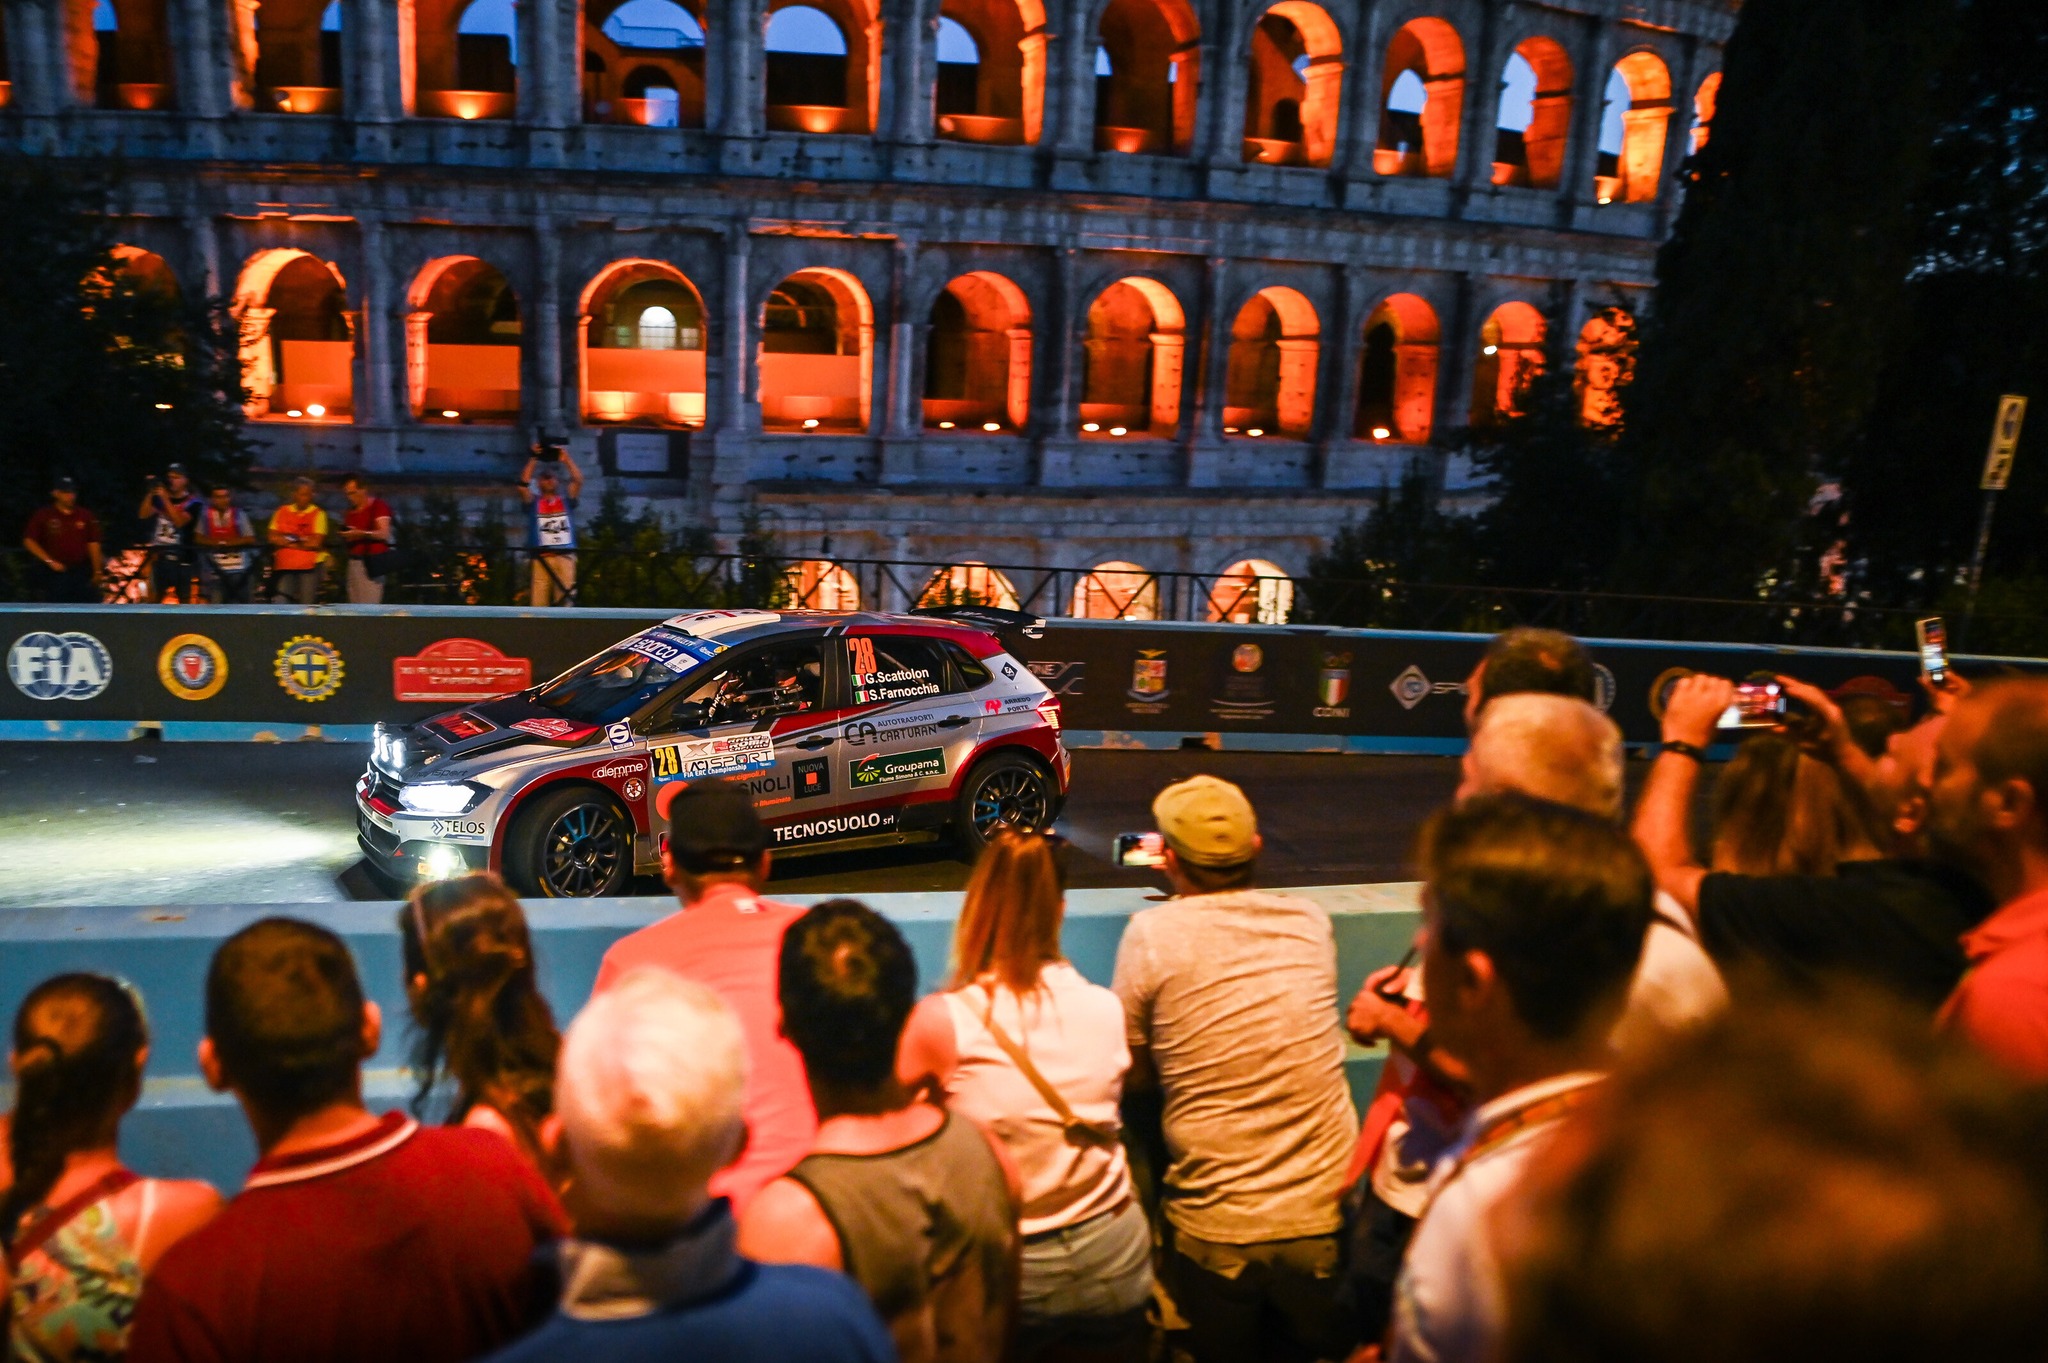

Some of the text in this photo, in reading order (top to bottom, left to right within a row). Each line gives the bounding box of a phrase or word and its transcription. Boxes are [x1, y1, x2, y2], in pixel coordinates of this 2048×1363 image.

[849, 637, 878, 674] 28
[865, 668, 930, 684] G.Scattolon
[869, 682, 940, 701] S.Farnocchia
[1004, 697, 1031, 705] ARREDO
[877, 714, 935, 727] AUTOTRASPORTI
[880, 725, 938, 742] CARTURAN
[655, 746, 678, 776] 28
[691, 751, 772, 773] ACI SPORT
[798, 762, 825, 774] NUOVA
[885, 759, 939, 774] Groupama
[707, 764, 747, 775] Championship
[804, 784, 822, 793] LUCE
[444, 820, 485, 834] TELOS
[773, 812, 894, 842] TECNOSUOLO srl
